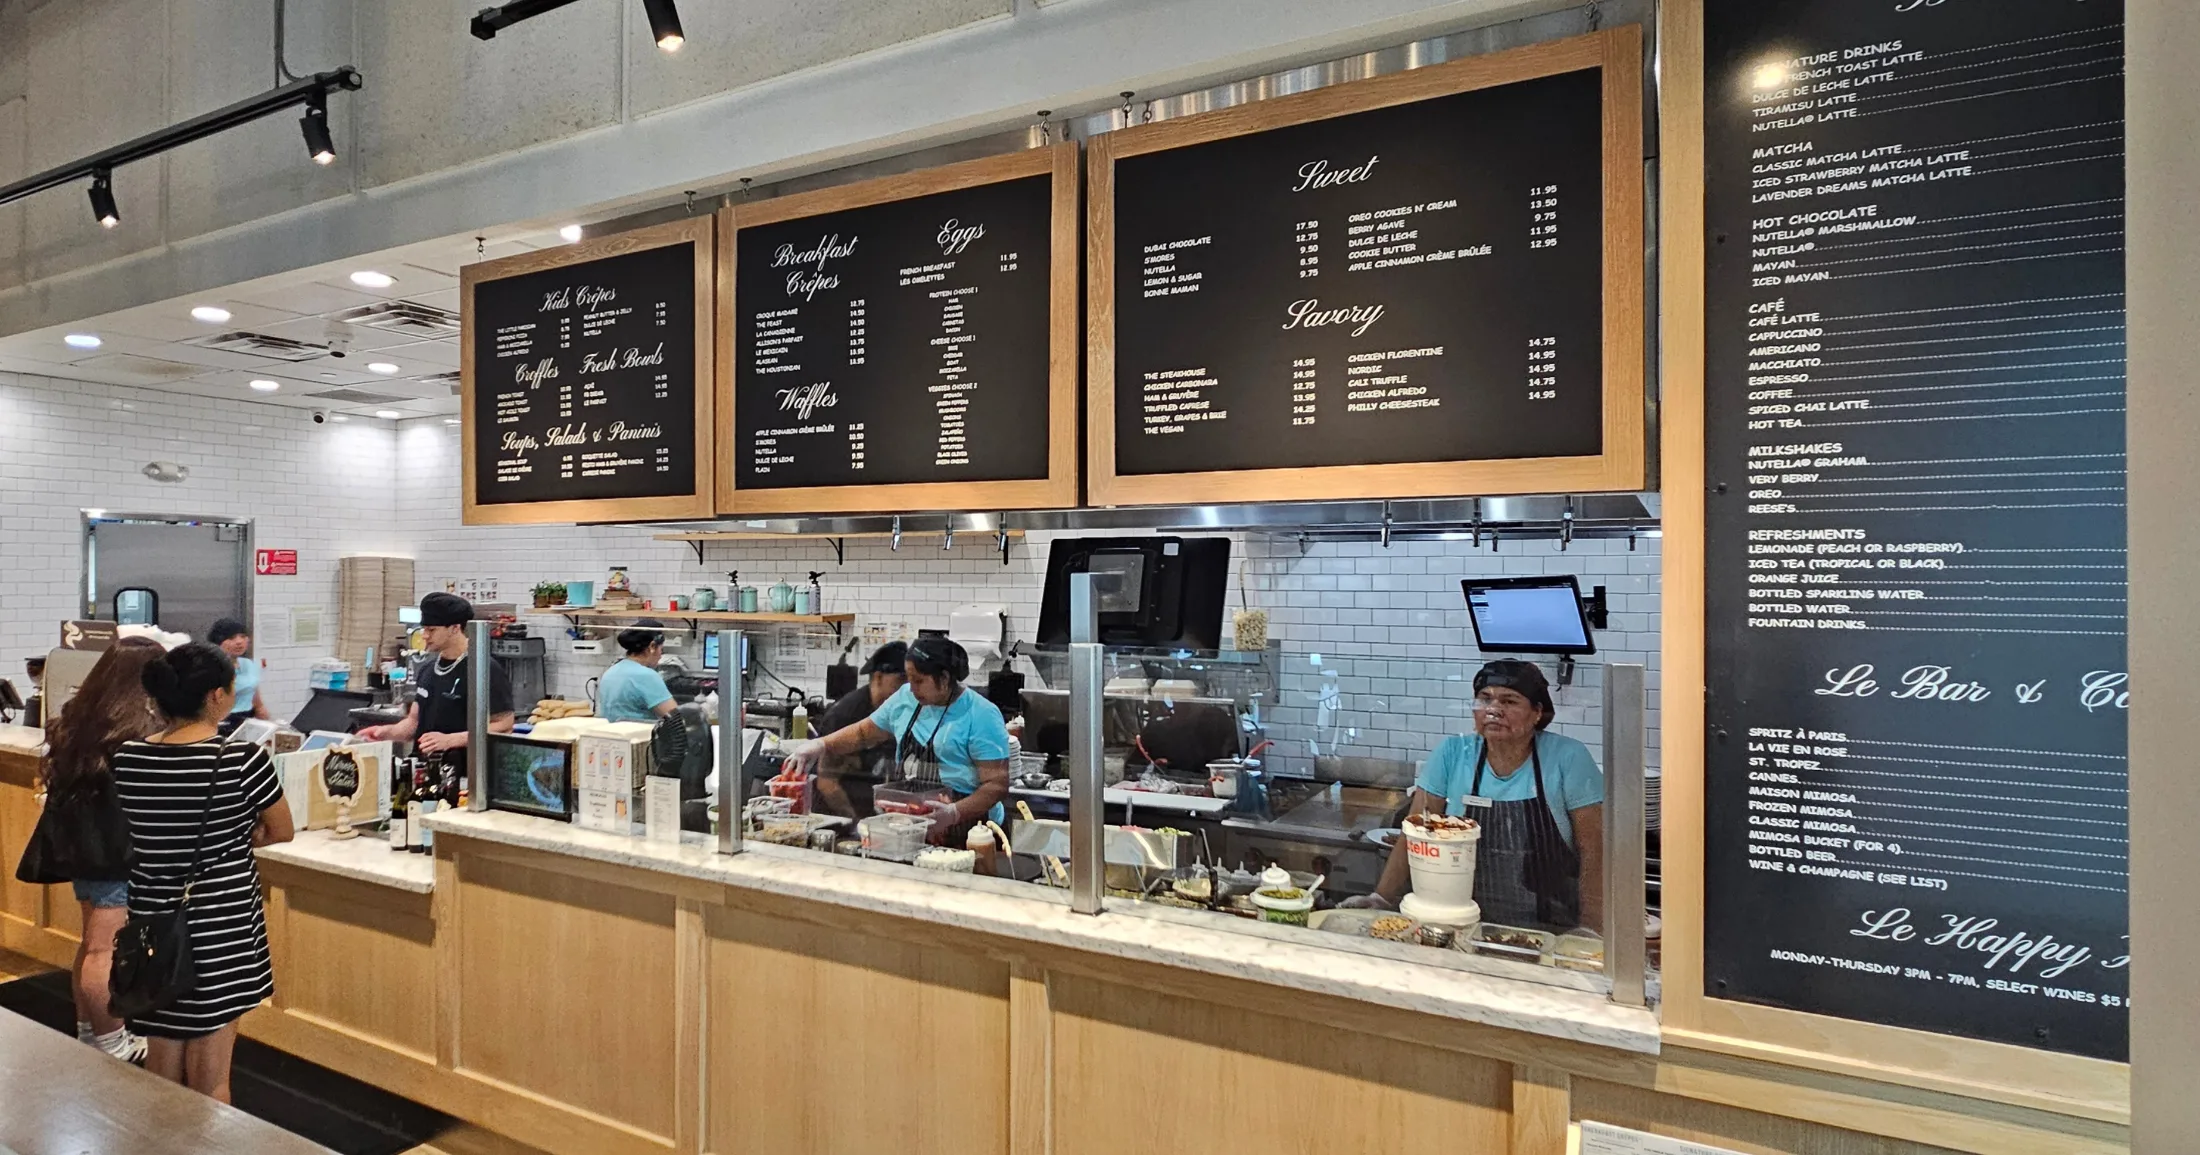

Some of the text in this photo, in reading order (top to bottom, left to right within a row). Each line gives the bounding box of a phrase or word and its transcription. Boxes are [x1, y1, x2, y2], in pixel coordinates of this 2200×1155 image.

[1844, 40, 1902, 59] DRINKS
[1785, 64, 1831, 84] FRENCH
[1835, 59, 1878, 73] TOAST
[1882, 51, 1923, 66] LATTE
[1752, 71, 1894, 103] DULCE DE LECHE LATTE
[1752, 141, 1813, 159] MATCHA
[1292, 156, 1379, 192] Sweet
[1752, 150, 1969, 188] ICED STRAWBERRY MATCHA LATTE
[1348, 212, 1372, 223] OREO
[1374, 206, 1412, 219] COOKIES
[1426, 200, 1457, 211] CREAM
[1531, 185, 1557, 196] 11.95
[1348, 198, 1557, 235] BERRY AGAVE 13.50
[1753, 205, 1877, 230] HOT CHOCOLATE
[1816, 214, 1917, 235] MARSHMALLOW
[937, 219, 986, 255] Eggs
[1144, 220, 1318, 253] DUBAI CHOCOLATE 17.50
[1296, 232, 1318, 242] 12.75
[770, 233, 858, 271] Breakfast
[1348, 238, 1557, 271] APPLE CINNAMON CRÈME BRÛLÉE 12.95
[900, 267, 922, 275] FRENCH
[923, 261, 956, 272] BREAKFAST
[1144, 265, 1175, 275] NUTELLA
[1144, 277, 1169, 287] LEMON
[1178, 272, 1202, 282] SUGAR
[1300, 256, 1318, 266] 8.95
[1752, 260, 1795, 272] MAYAN
[786, 271, 840, 302] Crêpes
[1144, 268, 1318, 298] BONNE MAMAN 9.75
[538, 287, 570, 312] Kids
[1748, 297, 1785, 313] CAFÉ
[1282, 299, 1384, 337] Savory
[1748, 328, 1823, 342] CAPPUCCINO
[579, 342, 663, 374] Fresh Bowls
[1348, 337, 1556, 363] CHICKEN FLORENTINE 14.75
[1748, 343, 1821, 356] AMERICANO
[1144, 358, 1315, 380] THE STEAKHOUSE 14.95
[1348, 350, 1556, 375] NORDIC 14.95
[1748, 358, 1821, 371] MACCHIATO
[1144, 378, 1218, 391] CHICKEN CARBONARA
[1348, 375, 1408, 387] CALI TRUFFLE
[1748, 374, 1809, 386] ESPRESSO
[775, 381, 838, 420] Waffles
[1144, 404, 1178, 412] TRUFFLED
[1293, 393, 1316, 402] 13.95
[1348, 390, 1556, 412] PHILLY CHEESESTEAK 14.95
[1748, 389, 1795, 400] COFFEE
[1202, 412, 1208, 420] &
[1748, 399, 1871, 415] SPICED CHAI LATTE
[544, 422, 587, 447] Salads
[607, 421, 661, 441] Paninis
[1144, 426, 1159, 434] THE
[1159, 425, 1184, 433] VEGAN
[1748, 443, 1843, 456] MILKSHAKES
[1748, 489, 1782, 499] OREO
[1748, 504, 1798, 514] REESE'S
[1748, 529, 1866, 541] REFRESHMENTS
[1748, 542, 1966, 555] LEMONADE (PEACH OR RASPBERRY)
[1748, 589, 1926, 600] BOTTLED SPARKLING WATER
[1748, 618, 1868, 630] FOUNTAIN DRINKS
[1814, 664, 1879, 697] Le
[1891, 665, 1991, 702] Bar
[1748, 727, 1849, 742] SPRITZ À PARIS
[1749, 742, 1849, 757] LA VIE EN ROSE
[1748, 757, 1822, 771] ST. TROPEZ
[1748, 772, 1800, 784] CANNES
[1748, 786, 1858, 804] MAISON MIMOSA
[1748, 830, 1903, 855] MIMOSA BUCKET (FOR 4)
[1749, 844, 1838, 862] BOTTLED BEER
[1749, 859, 1948, 891] WINE & CHAMPAGNE (SEE LIST)
[1850, 908, 1916, 941] Le
[1924, 914, 2092, 979] Happy
[1770, 949, 1900, 975] MONDAY-THURSDAY
[1904, 967, 1931, 980] 3PM
[1948, 973, 1980, 988] 7PM,
[1985, 979, 2039, 994] SELECT
[2043, 987, 2096, 1003] WINES
[2101, 994, 2121, 1007] $5
